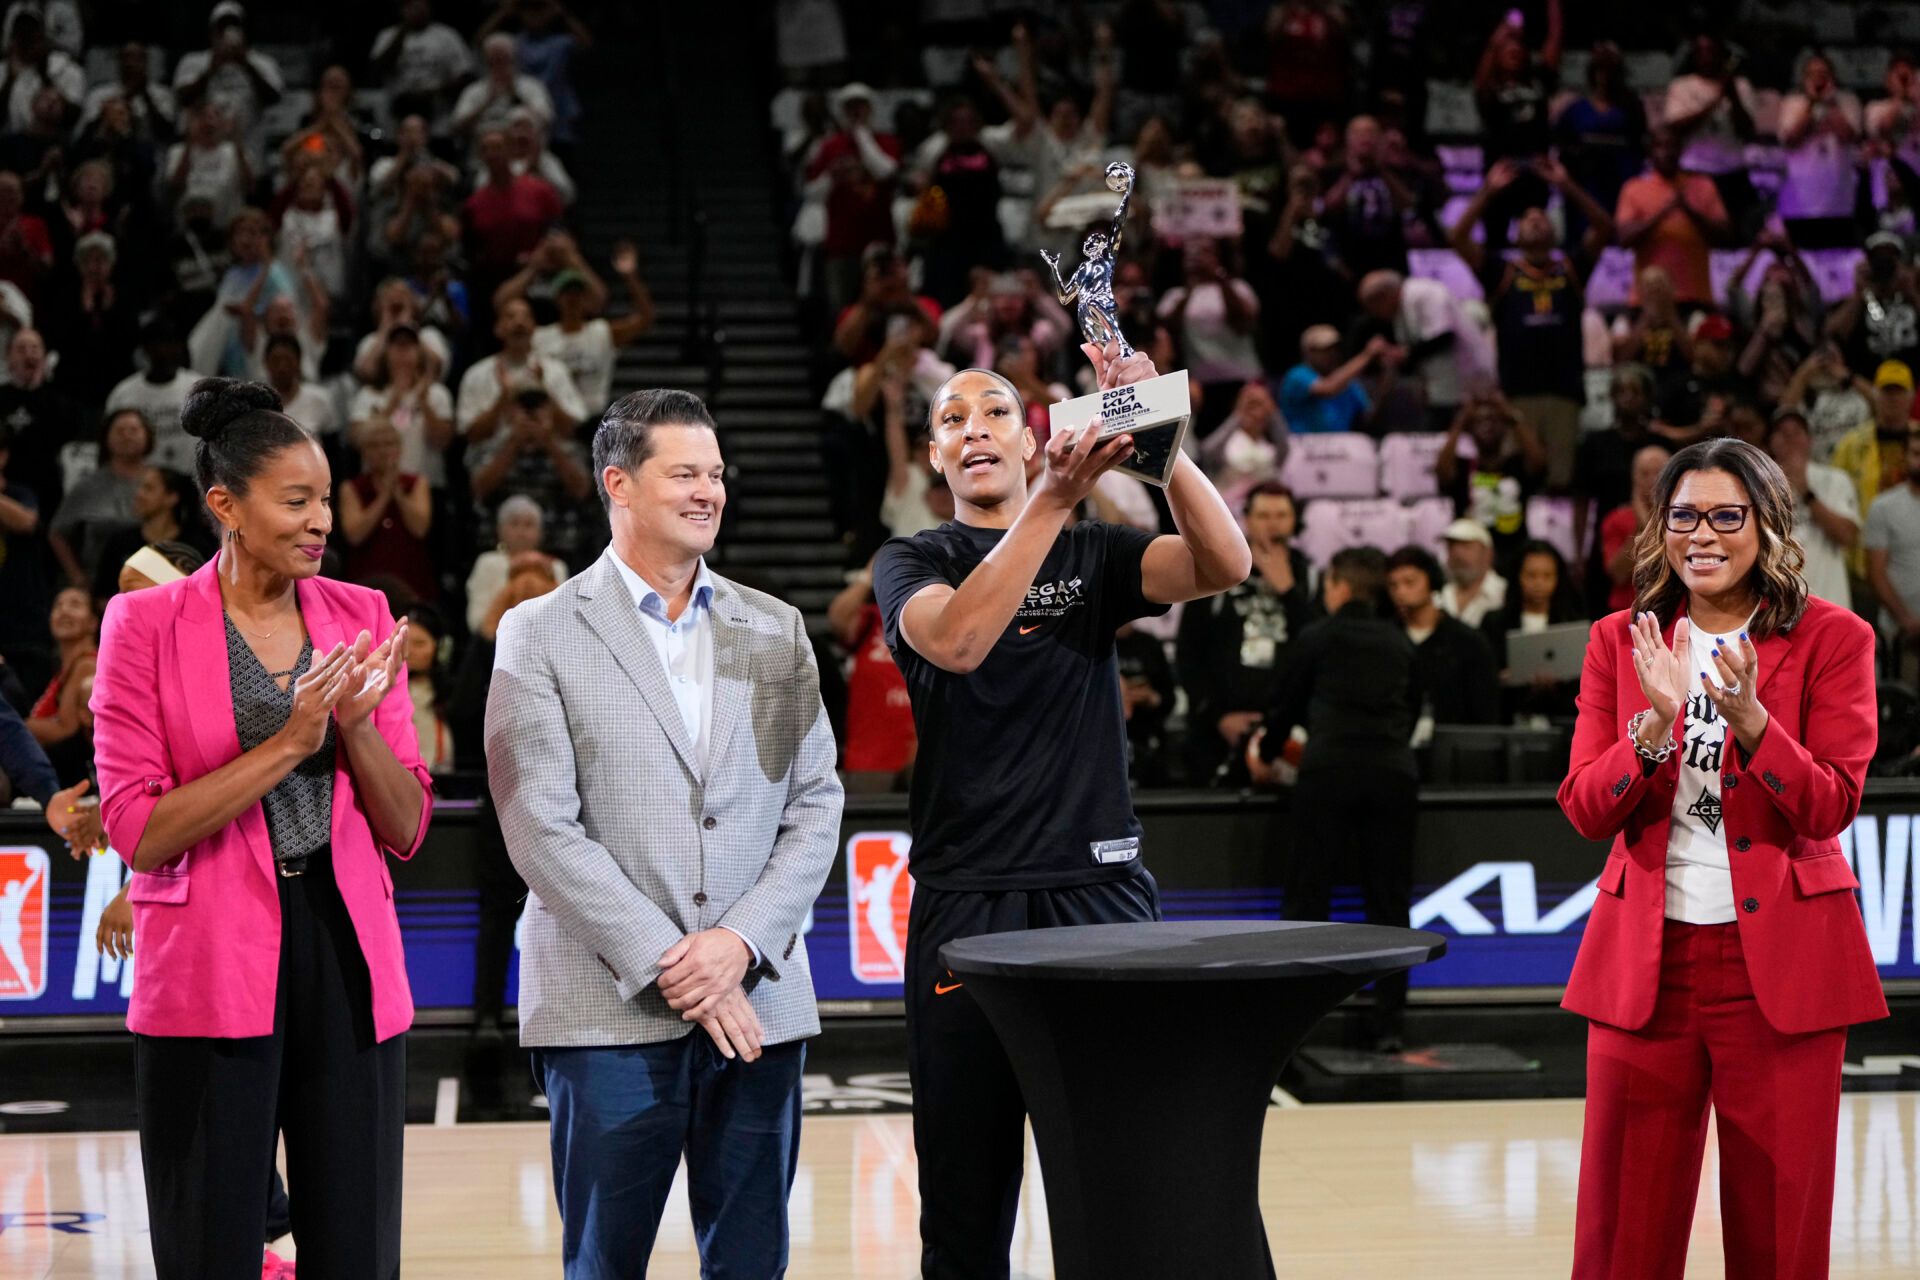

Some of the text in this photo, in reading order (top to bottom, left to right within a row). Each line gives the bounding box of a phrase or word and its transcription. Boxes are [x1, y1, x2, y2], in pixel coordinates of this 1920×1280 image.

[1102, 386, 1135, 401] 2025
[1103, 394, 1135, 409] KIA
[1100, 402, 1143, 418] WNBA
[1027, 576, 1082, 598] EGAS
[1689, 805, 1721, 815] ACE
